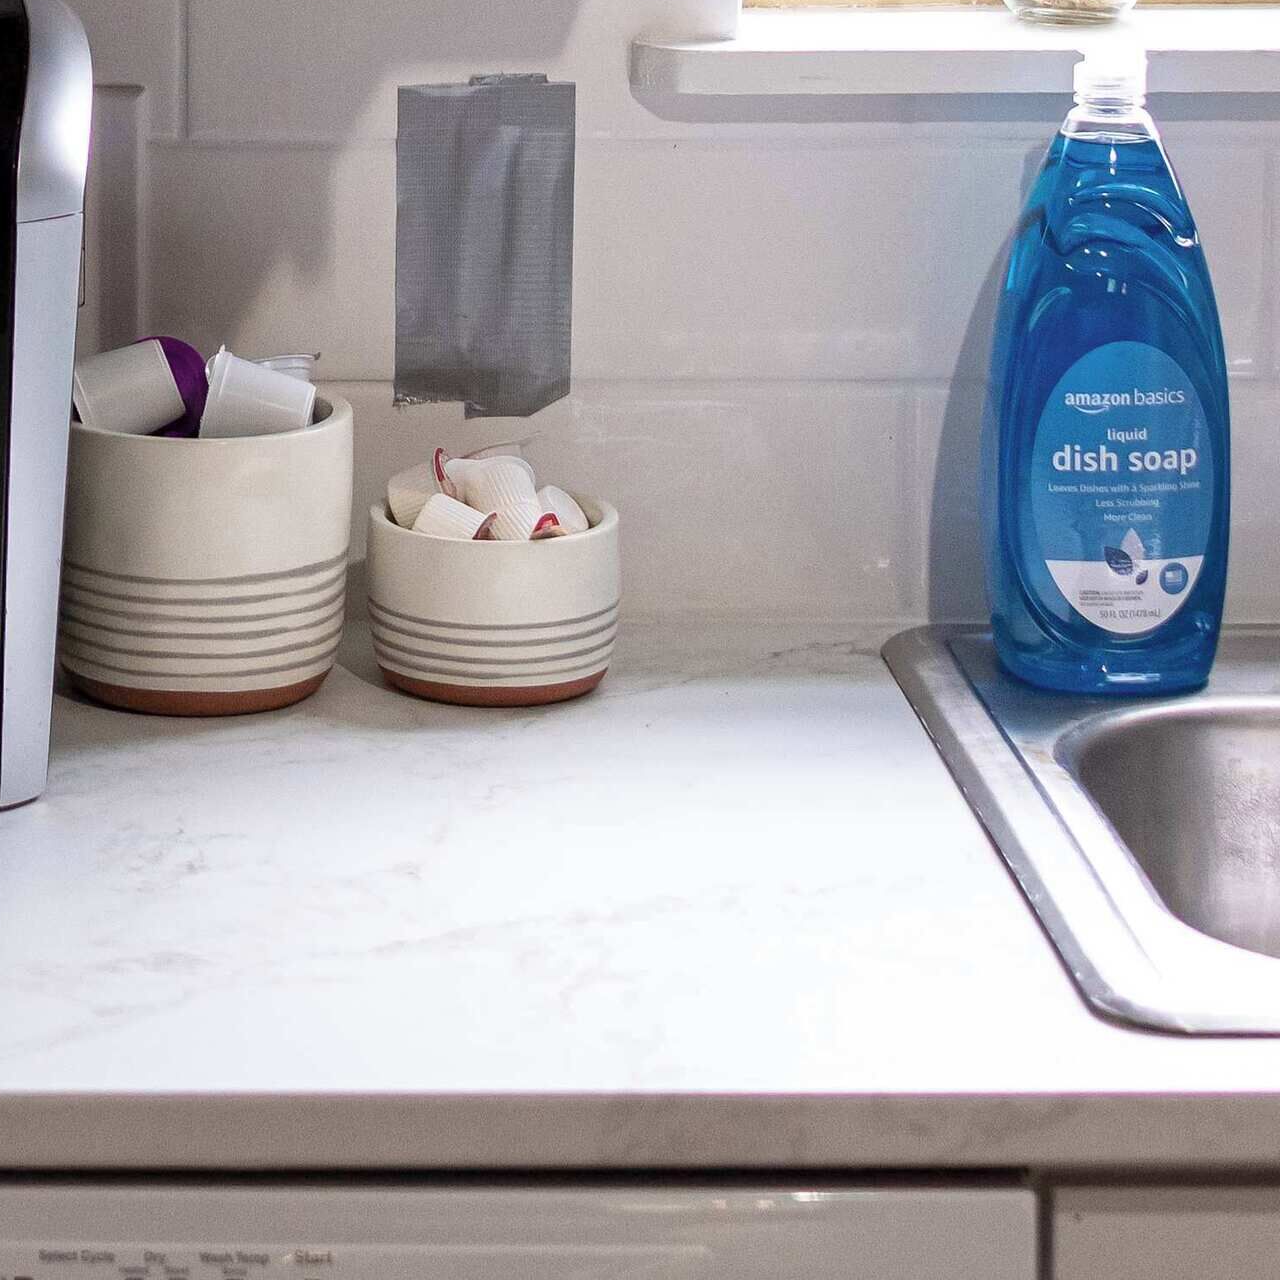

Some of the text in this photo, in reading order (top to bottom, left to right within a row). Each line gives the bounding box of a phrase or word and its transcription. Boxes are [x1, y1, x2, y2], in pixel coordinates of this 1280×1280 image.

[1064, 388, 1186, 407] amazon basics
[1107, 427, 1148, 443] liquid
[1052, 444, 1198, 475] dish soap
[1080, 483, 1110, 493] Dishes
[1110, 483, 1130, 493] with
[1095, 498, 1161, 509] Less Scrubbing
[1103, 512, 1153, 522] More Clean
[1099, 610, 1109, 619] 50
[143, 1249, 167, 1265] Dry
[294, 1249, 334, 1265] Start
